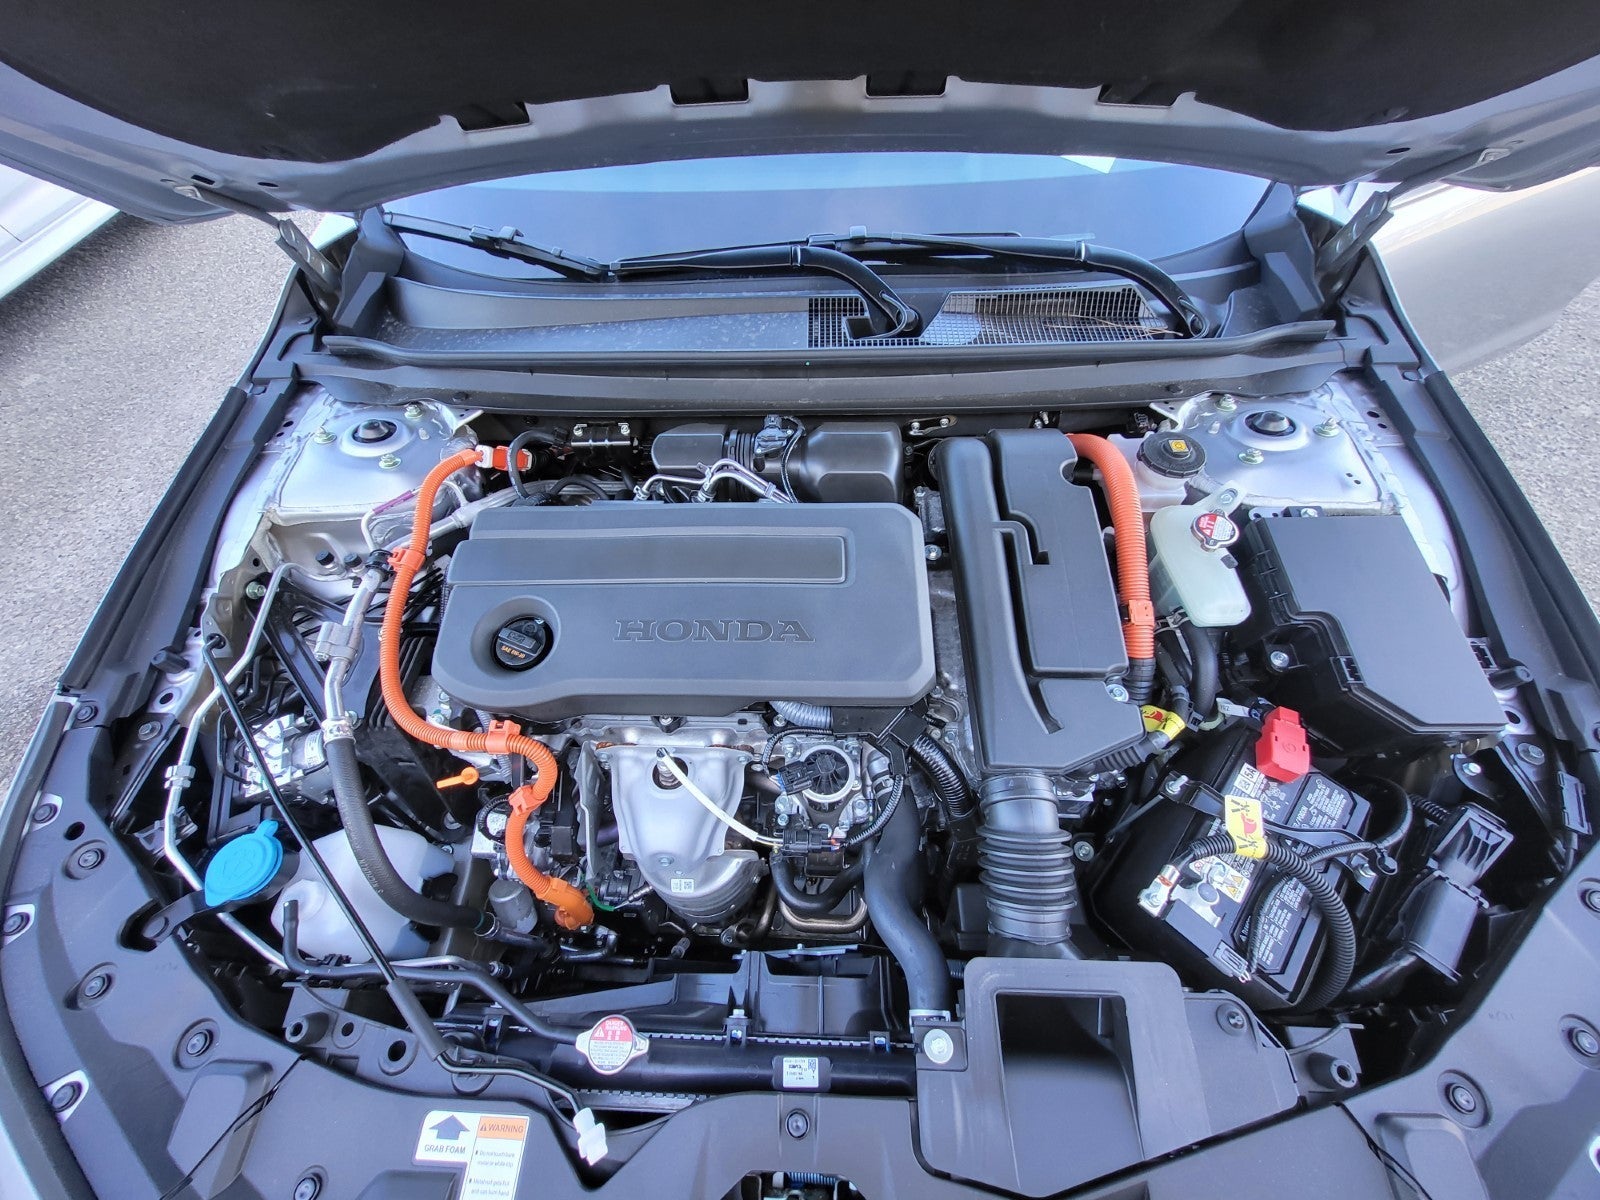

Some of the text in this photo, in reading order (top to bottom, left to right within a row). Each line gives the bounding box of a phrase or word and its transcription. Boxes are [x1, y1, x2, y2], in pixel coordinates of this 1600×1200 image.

[613, 619, 816, 643] HONDA
[488, 1123, 524, 1134] WARNING
[424, 1143, 466, 1154] GRAB FOAM
